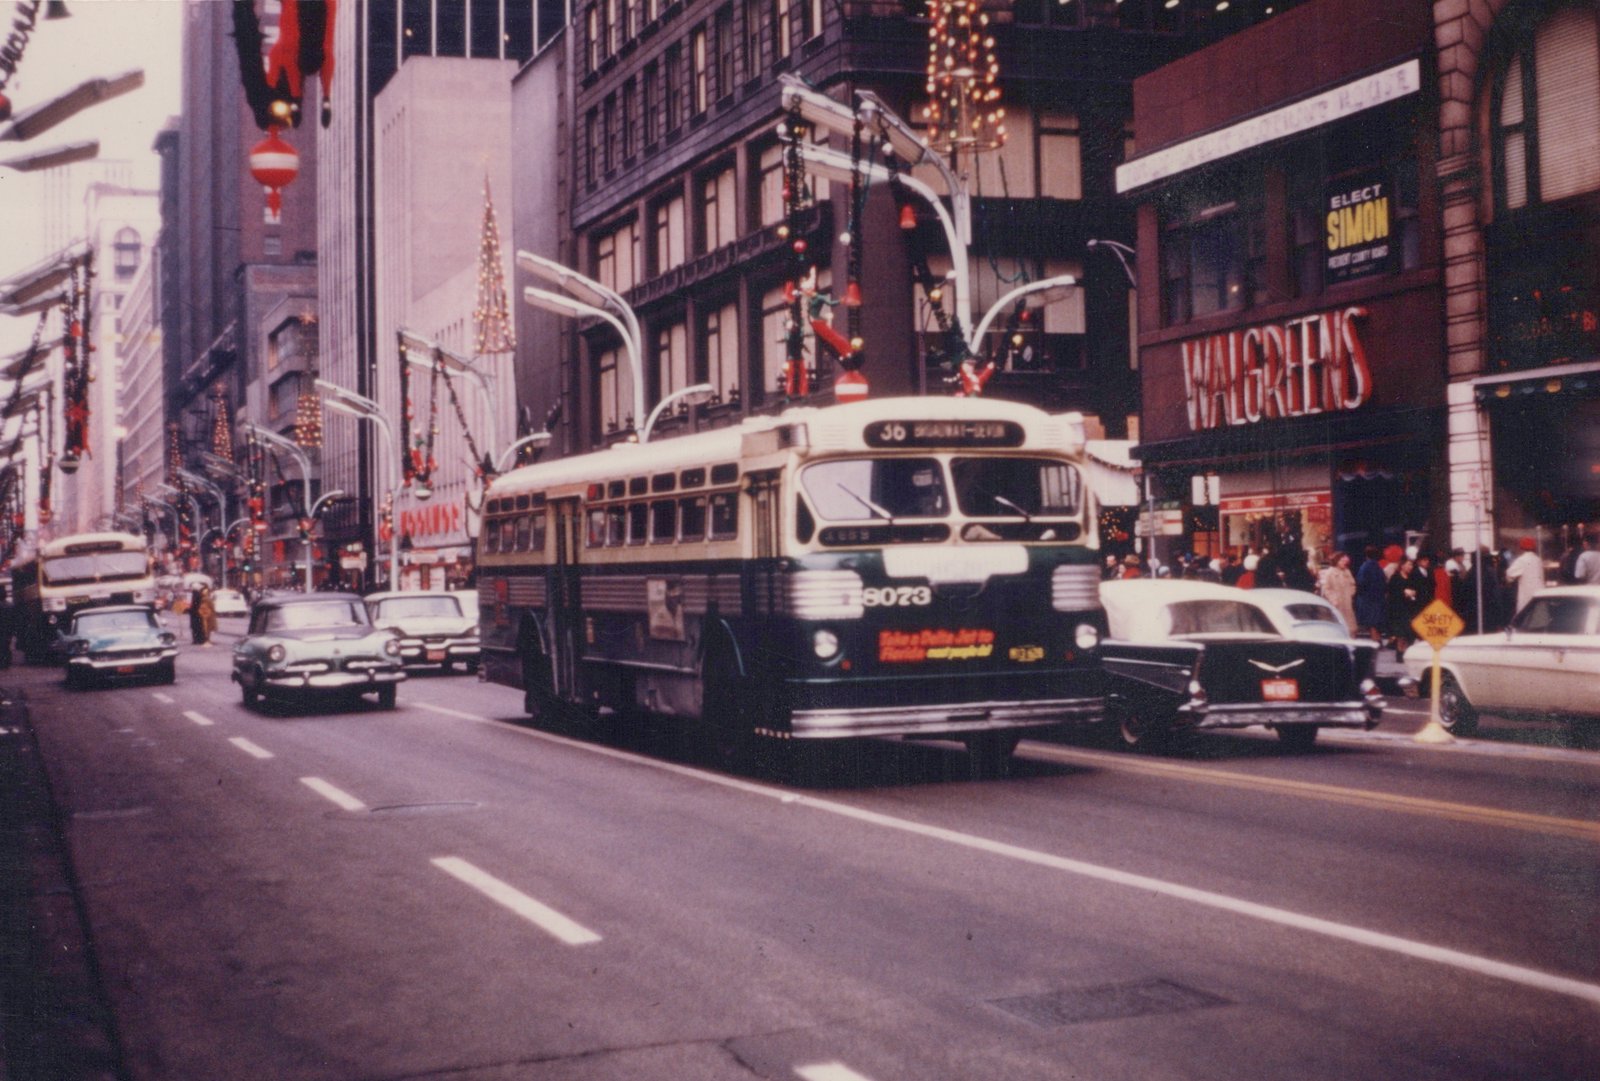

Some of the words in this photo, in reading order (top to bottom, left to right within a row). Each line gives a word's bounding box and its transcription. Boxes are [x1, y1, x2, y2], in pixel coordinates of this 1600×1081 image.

[1330, 183, 1381, 209] ELECT
[1326, 196, 1389, 251] SIMON
[1182, 306, 1372, 430] WALGREENS
[879, 423, 907, 441] 36
[861, 585, 932, 608] 8073
[1421, 613, 1453, 625] SAFETY
[1426, 626, 1449, 637] ZONE
